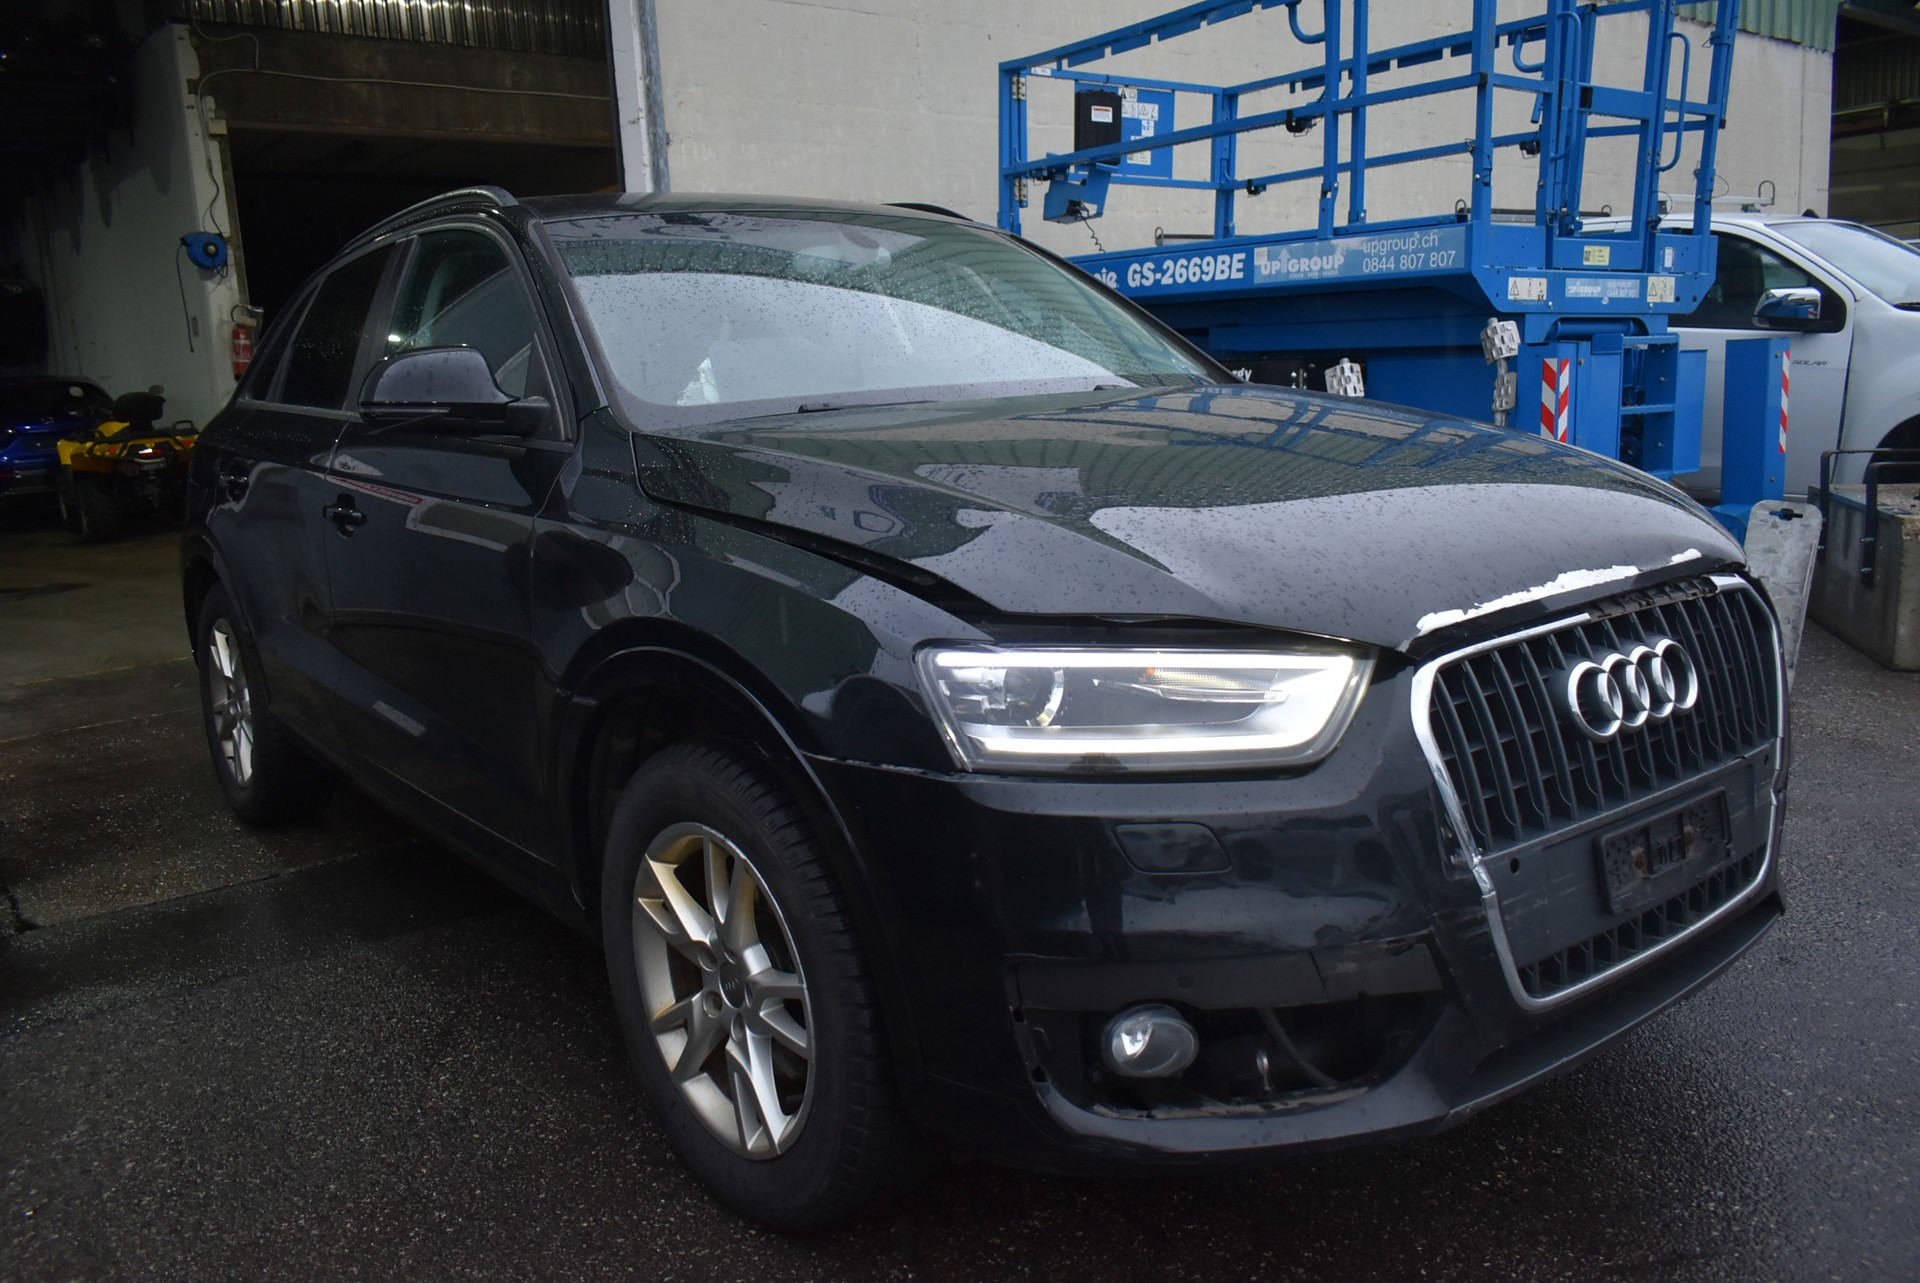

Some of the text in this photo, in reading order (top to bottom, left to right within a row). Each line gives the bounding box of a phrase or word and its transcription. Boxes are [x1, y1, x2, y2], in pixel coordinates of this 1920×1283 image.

[1363, 232, 1438, 256] upgroup.ch
[1127, 253, 1246, 288] GS-2669BE
[1363, 250, 1456, 273] 0844 807 807
